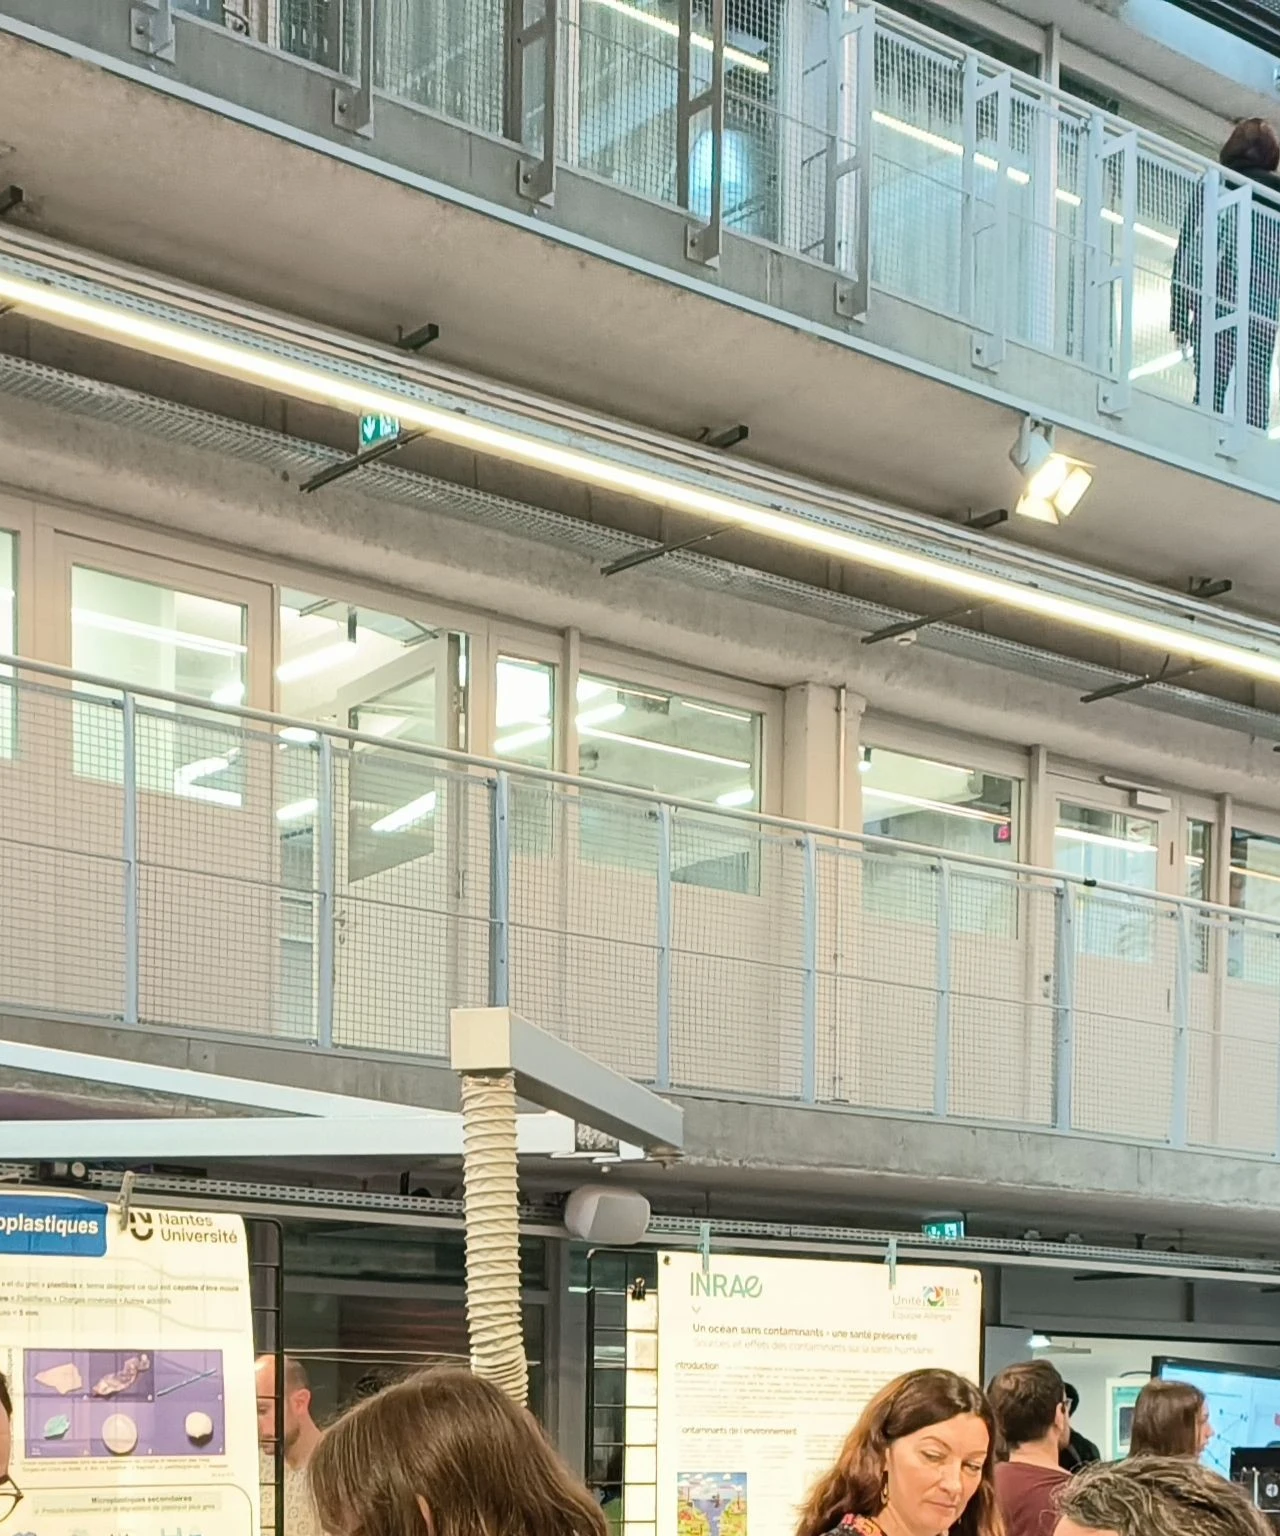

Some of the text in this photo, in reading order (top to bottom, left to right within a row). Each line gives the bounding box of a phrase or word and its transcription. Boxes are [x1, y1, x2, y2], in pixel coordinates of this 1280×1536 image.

[158, 1213, 213, 1227] Nantes
[161, 1228, 238, 1244] Université
[693, 1324, 705, 1332] Un
[708, 1325, 738, 1334] océan
[741, 1327, 761, 1335] sans
[763, 1328, 823, 1337] contaminants
[849, 1330, 871, 1339] santé
[873, 1332, 918, 1341] préservée
